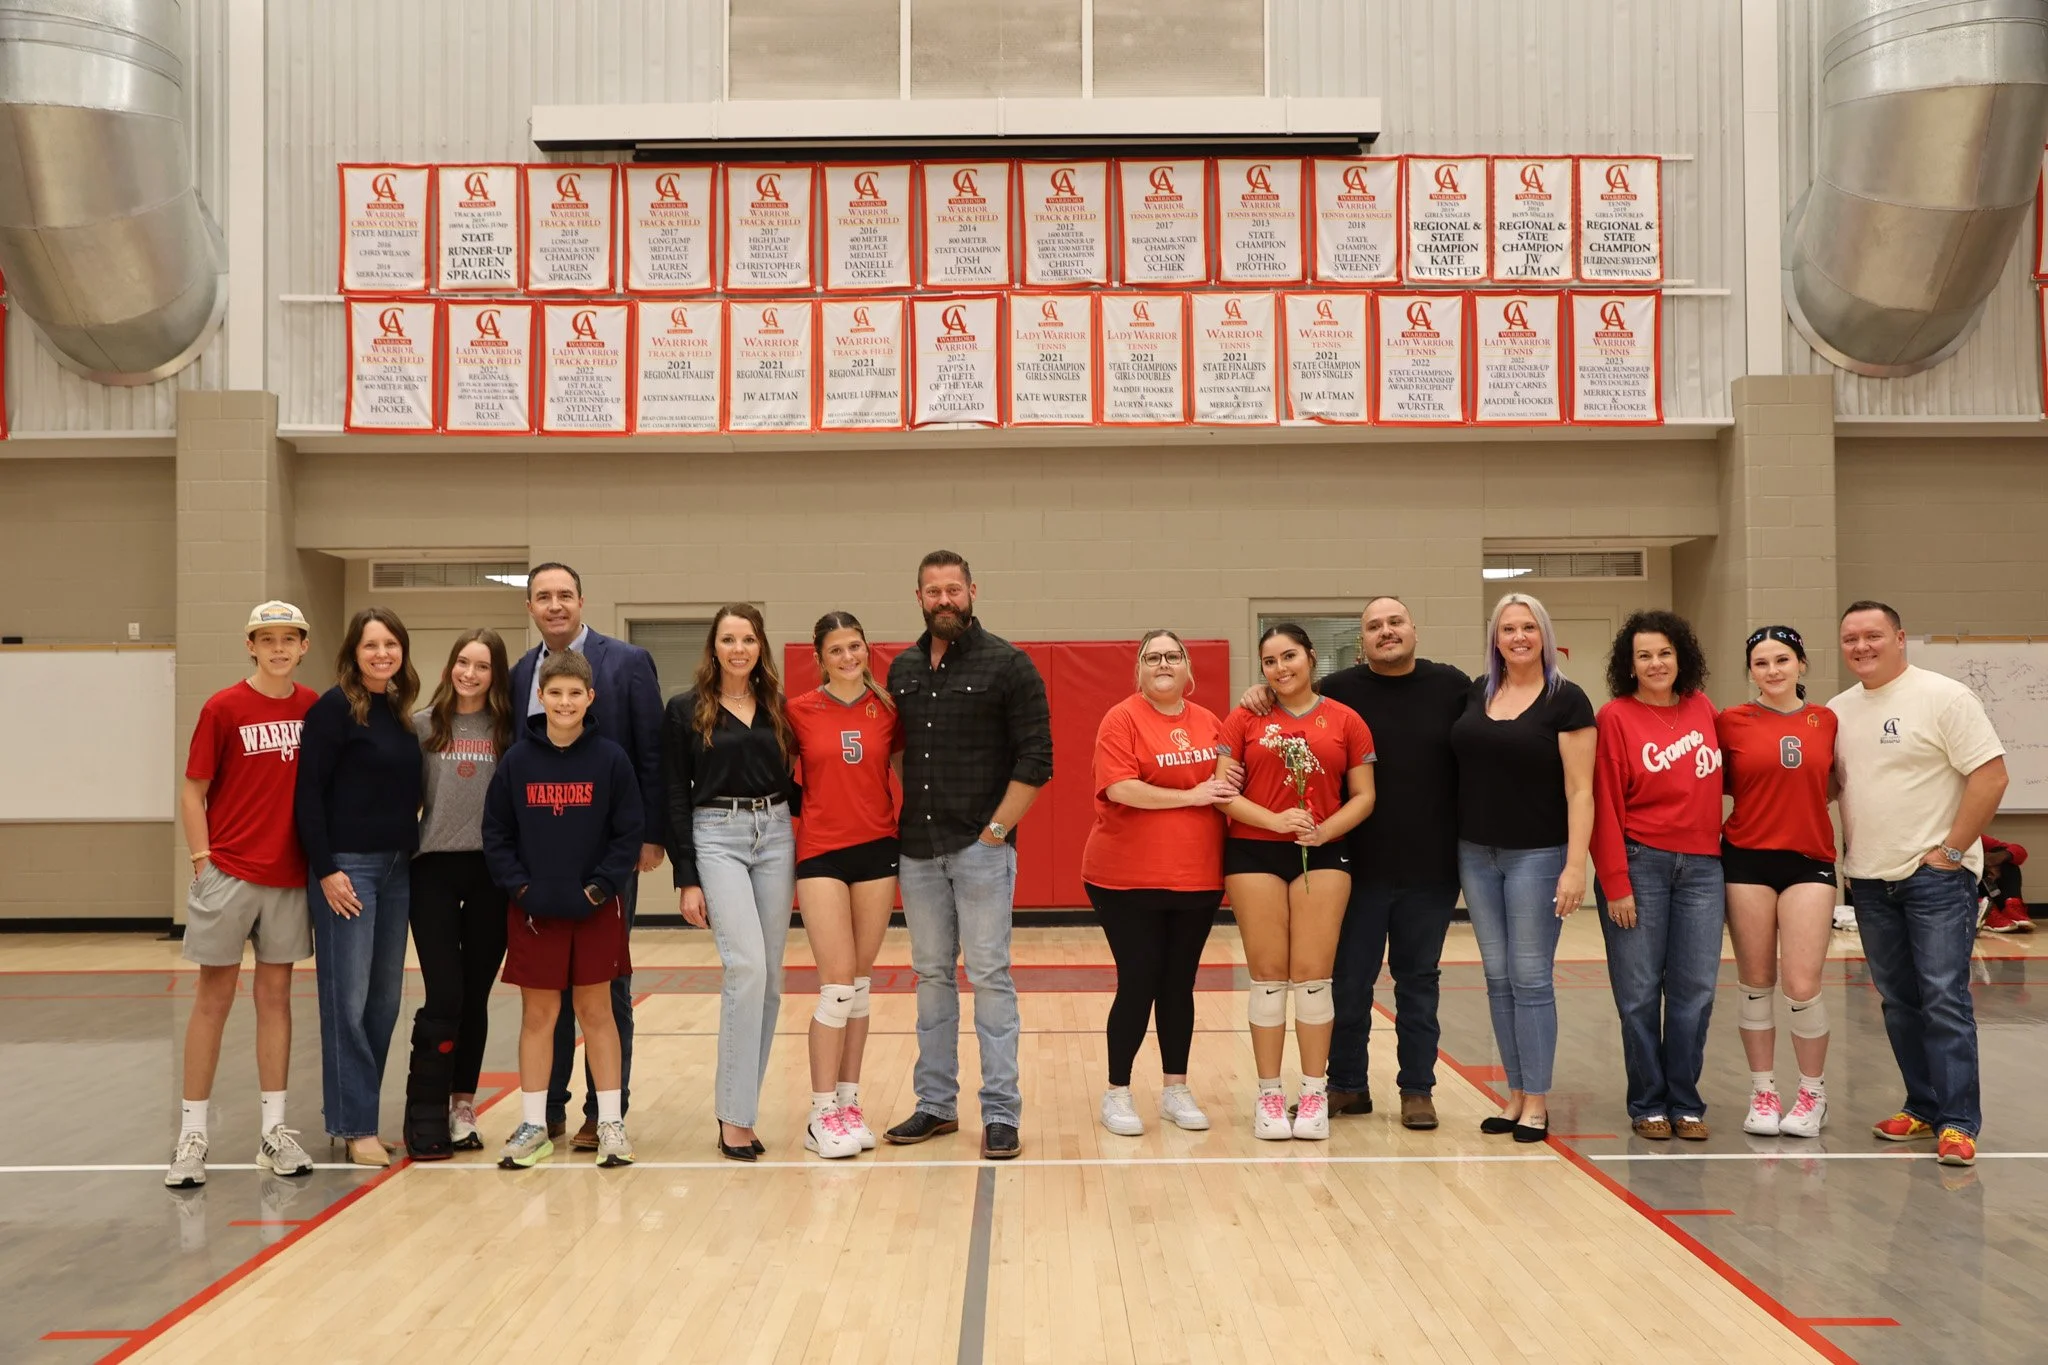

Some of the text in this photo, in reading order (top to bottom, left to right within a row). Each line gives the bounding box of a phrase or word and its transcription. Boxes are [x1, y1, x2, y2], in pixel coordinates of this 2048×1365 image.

[1056, 223, 1074, 231] 2012
[1348, 221, 1366, 229] 2018
[1414, 222, 1481, 230] REGIONAL &
[1500, 221, 1567, 230] REGIONAL &
[1587, 220, 1642, 230] REGIONAL
[462, 233, 494, 242] STATE
[1431, 233, 1464, 241] STATE
[1518, 232, 1548, 241] STATE
[1604, 233, 1635, 241] STATE
[1236, 241, 1286, 249] CHAMPION
[1417, 244, 1478, 253] CHAMPION
[1503, 243, 1563, 252] CHAMPION
[1590, 243, 1650, 252] CHAMPION
[449, 247, 512, 255] RUNNER-UP
[545, 253, 594, 261] CHAMPION
[955, 256, 980, 265] JOSH
[1144, 254, 1185, 262] COLSON
[1248, 253, 1275, 262] JOHN
[1334, 254, 1380, 262] JULIENNE
[1431, 255, 1464, 265] KATE
[1525, 254, 1542, 264] JW
[453, 257, 504, 267] LAUREN
[736, 262, 801, 270] CHRISTOPHER
[845, 261, 893, 269] DANIELLE
[1049, 260, 1084, 268] CHRISTI
[652, 263, 688, 271] LAUREN
[945, 266, 991, 274] LUFFMAN
[1148, 263, 1184, 271] SCHIEK
[1237, 263, 1286, 271] PROTHRO
[1335, 263, 1380, 271] SWEENEY
[1415, 266, 1480, 276] WURSTER
[1507, 266, 1560, 276] ALTMAN
[447, 270, 510, 280] SPRAGINS
[648, 272, 692, 280] SPRAGINS
[852, 270, 887, 278] OKEKE
[1041, 268, 1092, 277] ROBERTSON
[549, 273, 592, 281] SPRAGINS
[1017, 330, 1086, 340] LADY WARRIOR
[1207, 329, 1263, 338] WARRIOR
[1299, 329, 1353, 338] WARRIOR
[652, 337, 708, 347] WARRIOR
[744, 338, 799, 347] WARRIOR
[1387, 338, 1454, 347] LADY WARRIOR
[1040, 354, 1062, 362] 2021
[1223, 353, 1247, 361] 2021
[1316, 352, 1338, 360] 2021
[668, 361, 691, 369] 2021
[760, 361, 783, 369] 2021
[852, 359, 874, 367] 2021
[1017, 363, 1085, 371] STATE CHAMPION
[1132, 363, 1177, 371] CHAMPIONS
[1203, 362, 1266, 371] STATE FINALISTS
[1318, 361, 1360, 369] CHAMPION
[644, 371, 714, 379] REGIONAL FINALIST
[737, 369, 805, 378] REGIONAL FINALIST
[829, 368, 896, 377] REGIONAL FINALIST
[1026, 372, 1080, 380] GIRLS SINGLES
[1115, 372, 1170, 380] GIRLS DOUBLES
[1215, 372, 1255, 381] 3RD PLACE
[1301, 370, 1353, 379] BOYS SINGLES
[743, 392, 798, 401] JW ALTMAN
[827, 392, 858, 400] SAMUEL
[1017, 393, 1087, 402] KATE WURSTER
[1300, 392, 1354, 401] JW ALTMAN
[1408, 393, 1433, 401] KATE
[371, 405, 412, 413] HOOKER
[475, 402, 504, 410] BELLA
[929, 403, 984, 411] ROUILLARD
[1398, 403, 1444, 411] WURSTER
[1584, 403, 1607, 411] BRICE
[558, 414, 612, 422] ROUILLARD
[841, 731, 862, 764] 5
[1642, 730, 1703, 772] Game
[1780, 736, 1802, 768] 6
[526, 784, 593, 804] WARRIORS
